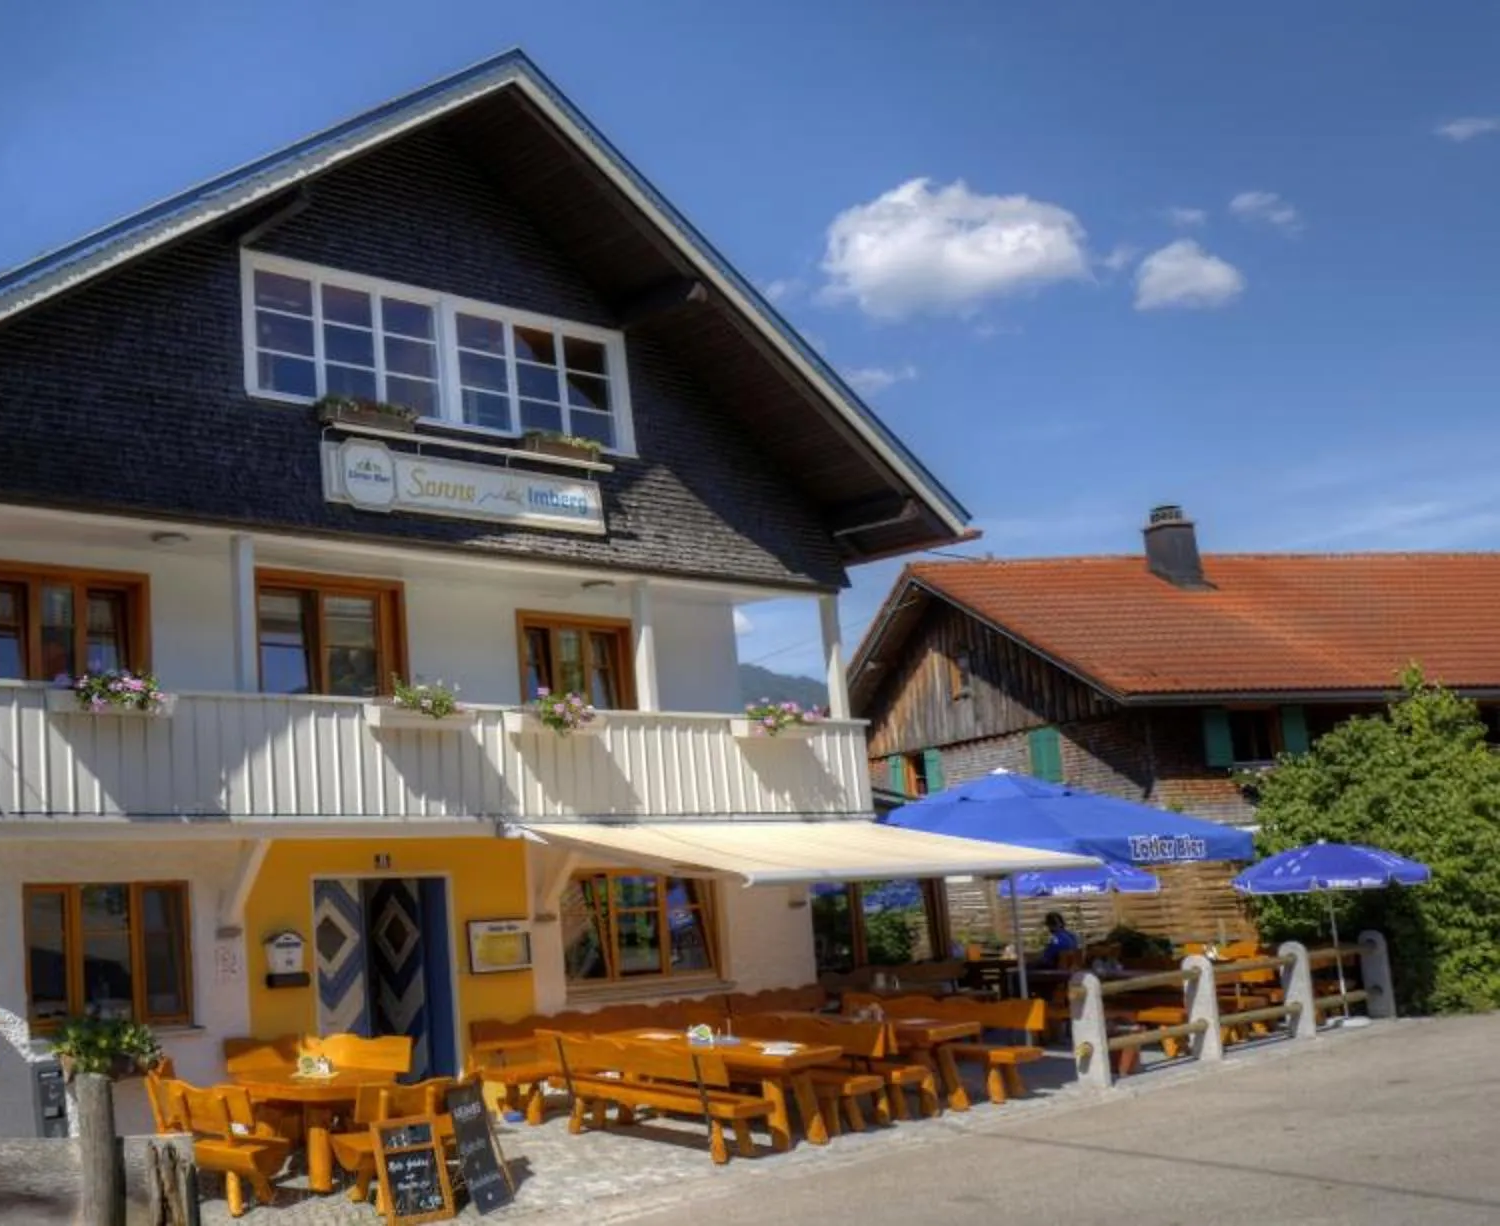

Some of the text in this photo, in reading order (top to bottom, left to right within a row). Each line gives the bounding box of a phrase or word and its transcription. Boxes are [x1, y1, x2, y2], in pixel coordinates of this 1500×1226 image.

[406, 467, 588, 514] Sonne Imberg
[1174, 834, 1206, 859] Bier
